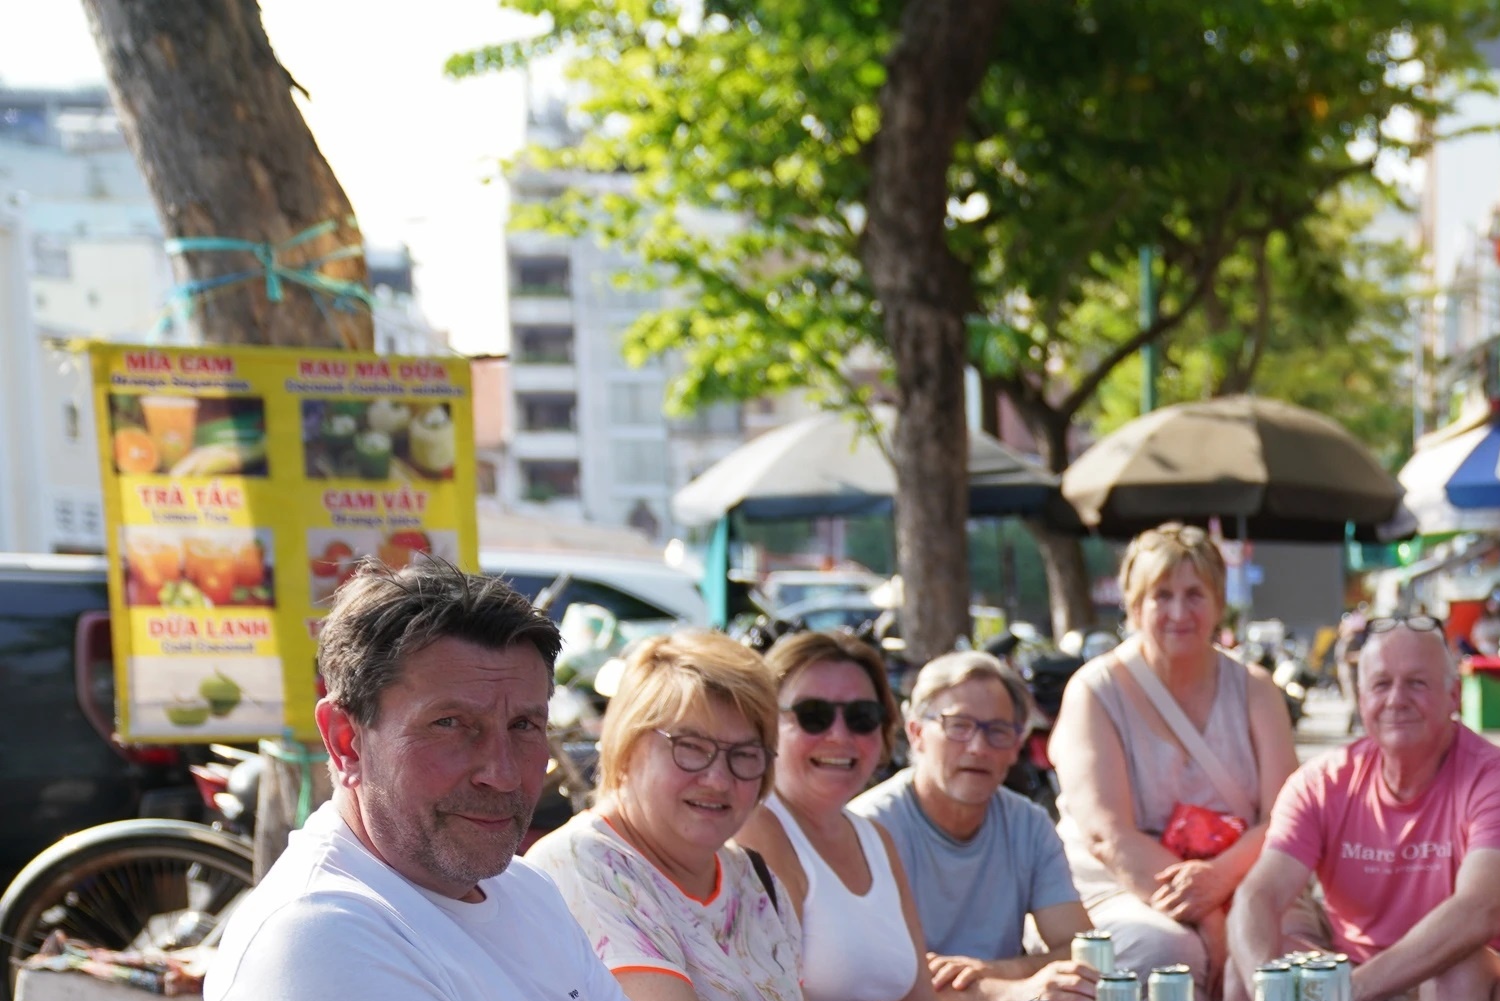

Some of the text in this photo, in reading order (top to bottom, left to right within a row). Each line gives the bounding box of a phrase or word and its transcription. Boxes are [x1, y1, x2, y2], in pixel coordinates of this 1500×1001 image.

[178, 353, 236, 376] CAM
[322, 488, 378, 512] CAM
[1341, 842, 1395, 862] Marc
